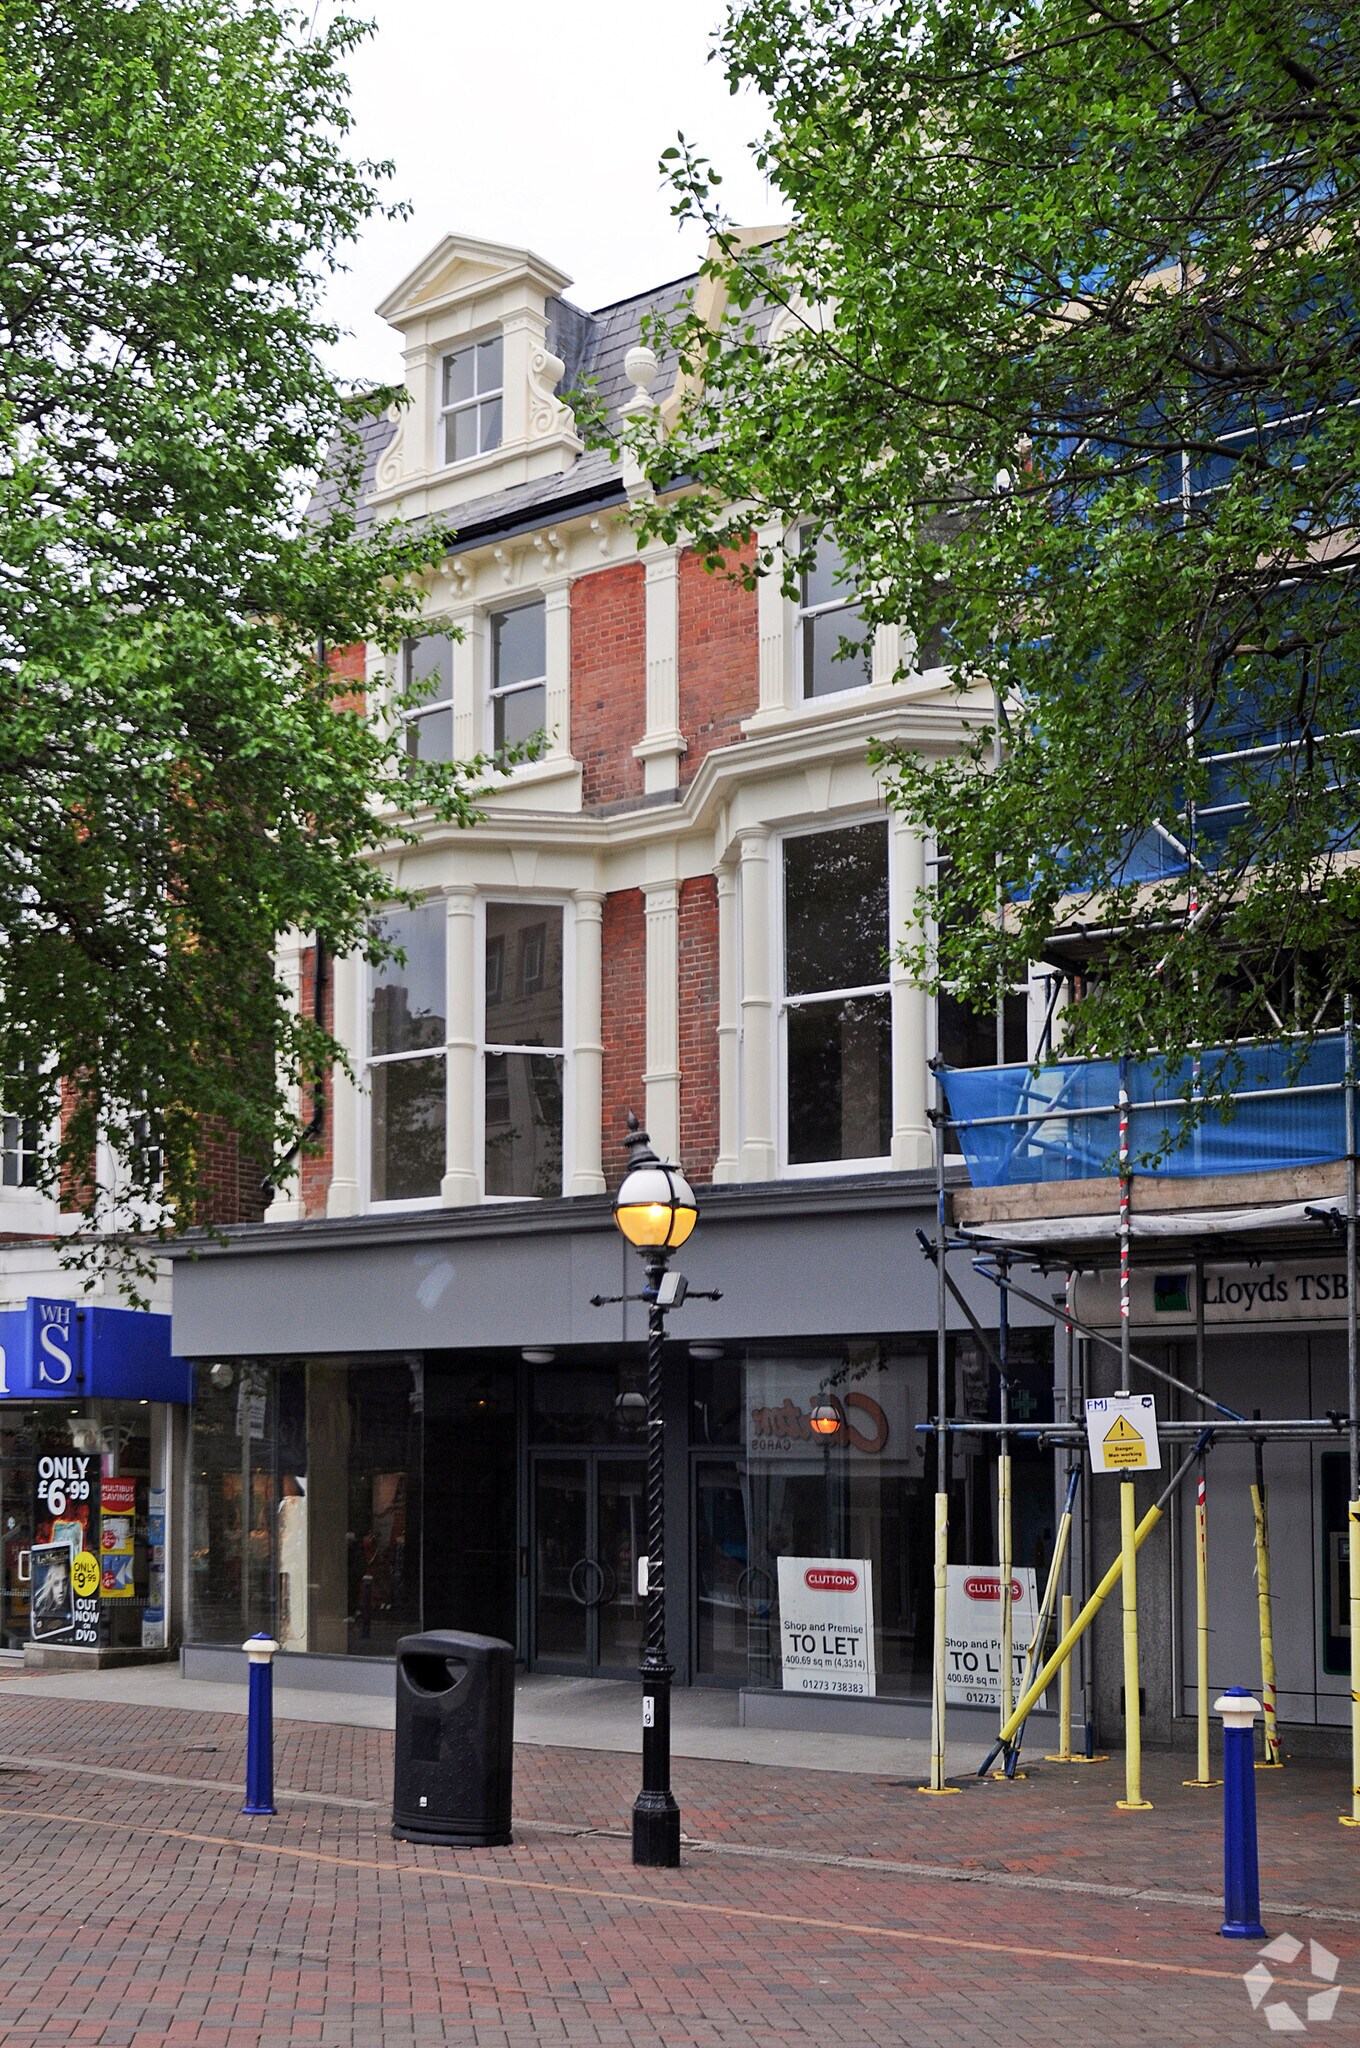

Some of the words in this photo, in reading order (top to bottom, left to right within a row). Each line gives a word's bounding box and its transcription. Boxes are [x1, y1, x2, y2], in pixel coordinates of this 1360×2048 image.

[1202, 1274, 1288, 1311] Lloyds
[1295, 1274, 1349, 1301] TSB
[40, 1304, 71, 1324] WH
[40, 1323, 72, 1384] S
[1087, 1400, 1108, 1411] FMJ
[38, 1456, 90, 1479] ONLY
[101, 1485, 135, 1493] MULTIBUY
[102, 1492, 135, 1501] SAVINGS
[74, 1562, 97, 1572] ONLY
[808, 1574, 855, 1586] CLUTTONS
[968, 1583, 1019, 1595] CLUTTS
[76, 1598, 98, 1611] OUT
[75, 1610, 100, 1623] NOW
[784, 1620, 807, 1632] Shop
[809, 1623, 826, 1632] and
[828, 1623, 864, 1634] Premise
[75, 1629, 97, 1642] DVD
[789, 1634, 816, 1653] TO
[822, 1635, 859, 1656] LET
[945, 1637, 968, 1650] Shop
[970, 1639, 988, 1649] and
[785, 1655, 811, 1665] 400.69
[813, 1658, 823, 1668] sq
[825, 1658, 833, 1666] m
[834, 1657, 866, 1670] (4,3314)
[950, 1651, 979, 1672] TO
[985, 1653, 1026, 1674] LT
[802, 1679, 829, 1691] 01273
[832, 1681, 864, 1693] 738383
[946, 1673, 974, 1684] 400.69
[976, 1675, 987, 1686] sq
[989, 1677, 998, 1685] m
[966, 1692, 996, 1704] 01273
